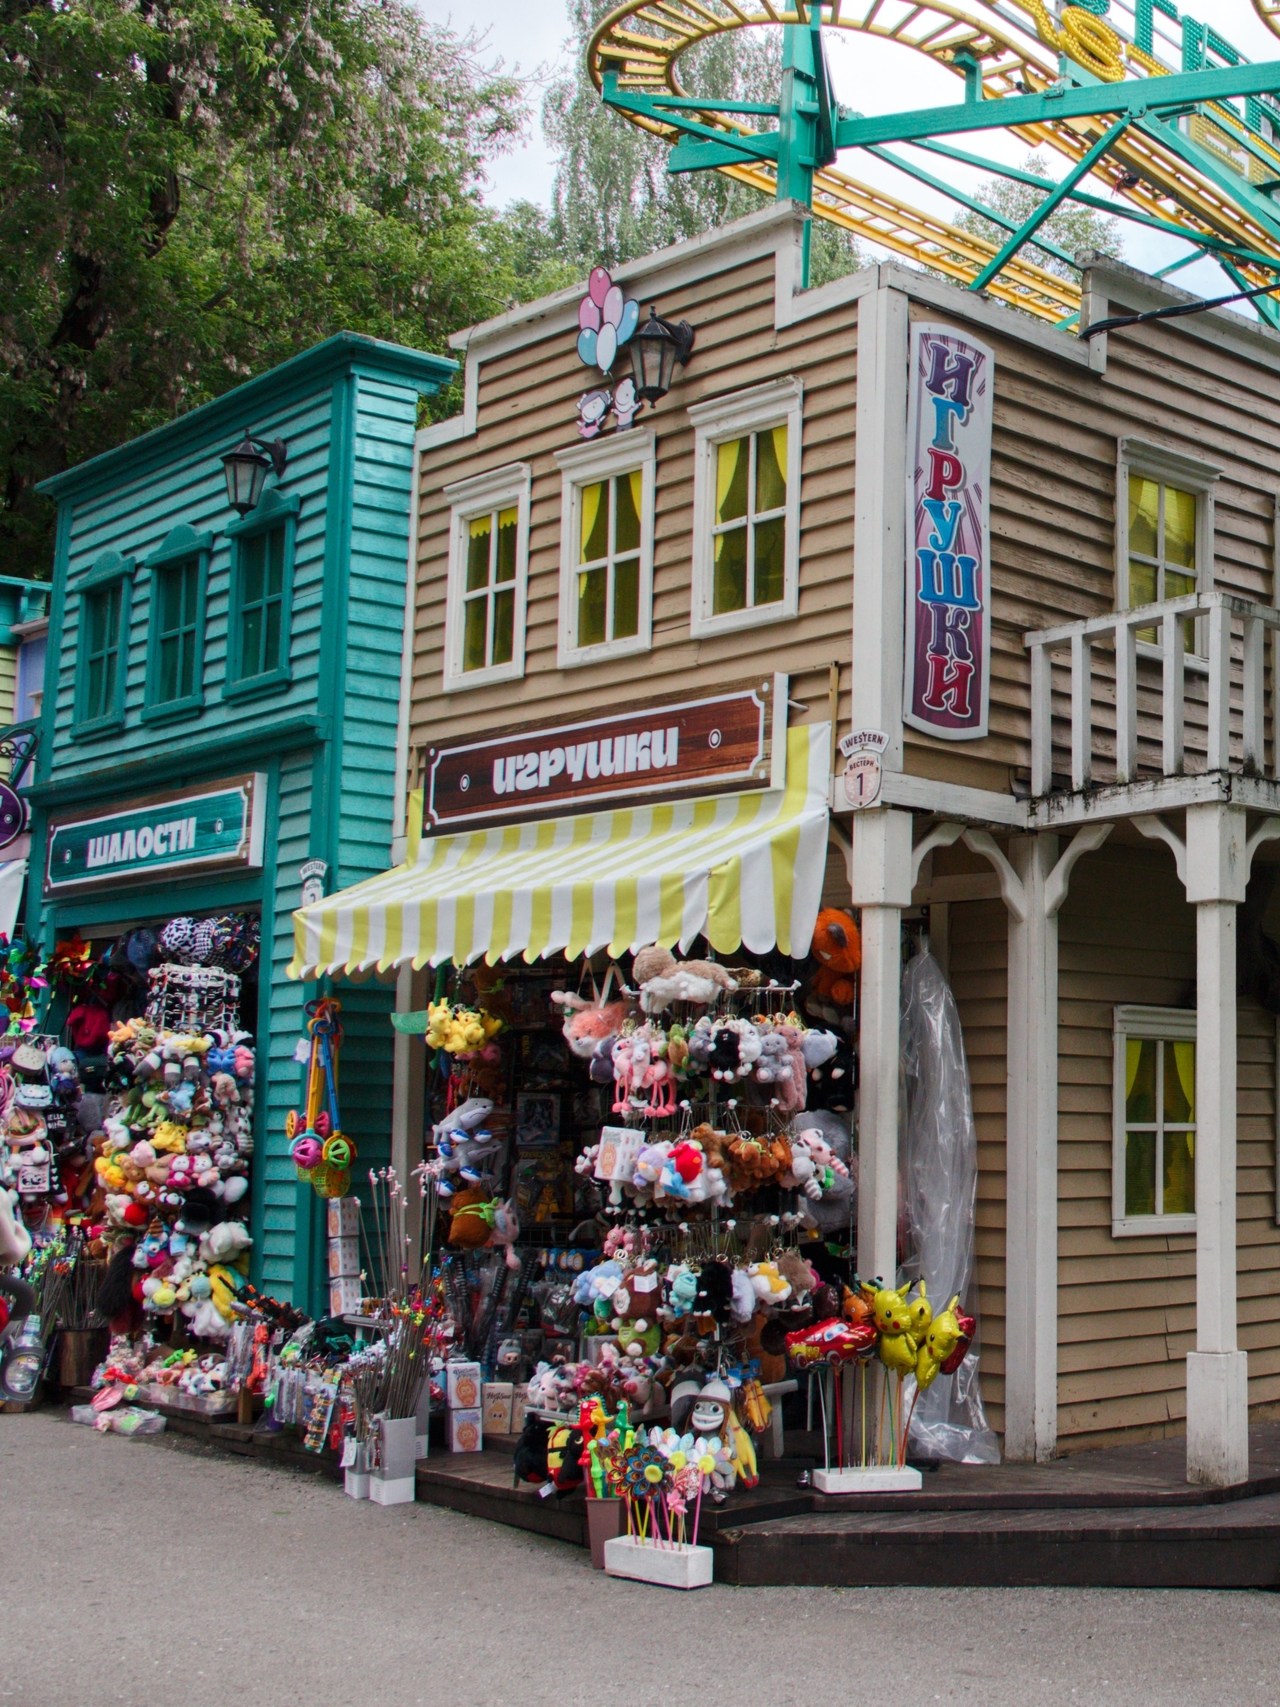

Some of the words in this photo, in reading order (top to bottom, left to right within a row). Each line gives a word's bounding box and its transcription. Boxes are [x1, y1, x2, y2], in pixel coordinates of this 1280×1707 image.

[917, 341, 980, 719] ИГРУШКИ
[845, 732, 884, 749] WESTERN
[849, 759, 875, 771] ВЕСТЕРН
[856, 772, 864, 796] 1
[86, 816, 198, 869] ШАЛОСТИ
